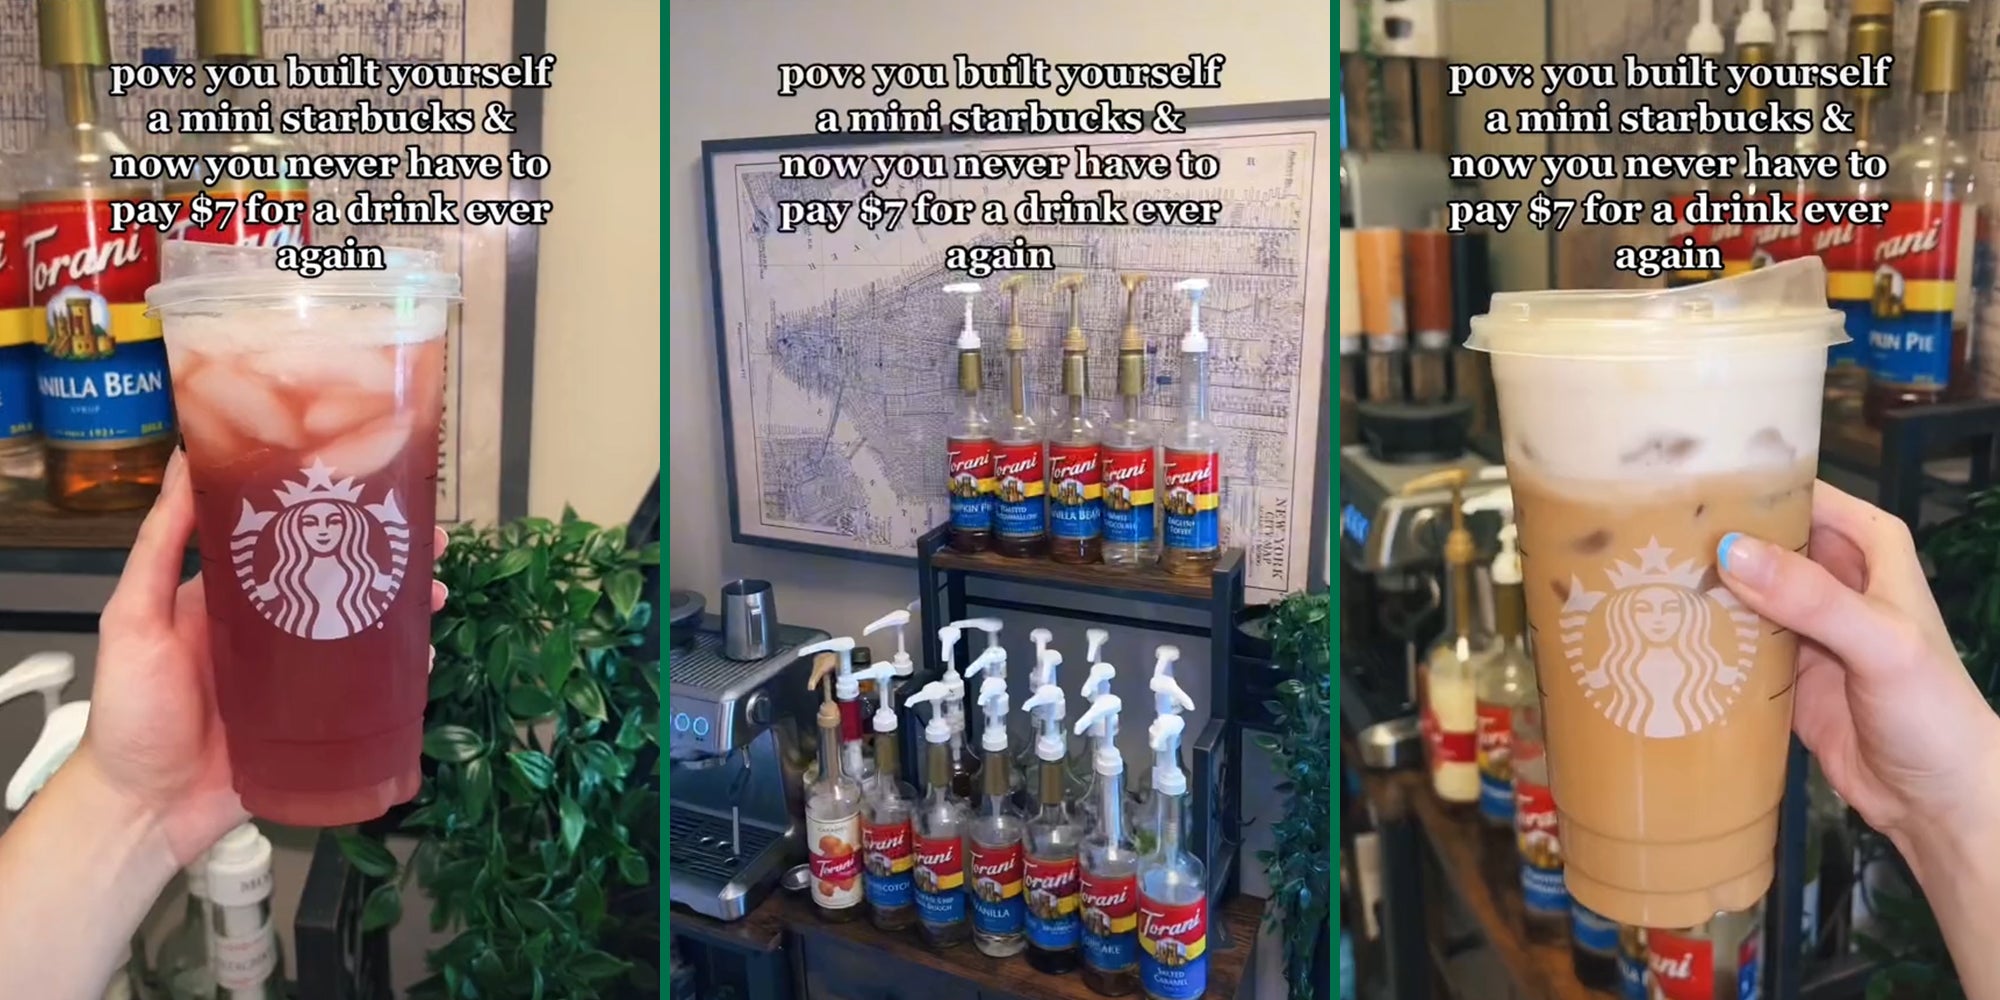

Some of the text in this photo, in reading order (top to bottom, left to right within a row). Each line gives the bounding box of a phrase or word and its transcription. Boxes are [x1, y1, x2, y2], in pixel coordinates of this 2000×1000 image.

[1874, 219, 1942, 261] rani
[24, 226, 141, 306] Torani
[1906, 331, 1934, 353] PIE
[104, 371, 162, 398] BEAN
[947, 450, 991, 474] Torani
[993, 452, 1038, 478] Torani
[1050, 453, 1098, 481] Torani
[1163, 462, 1212, 486] Torani
[1263, 511, 1275, 565] CITY MAP
[1272, 497, 1288, 580] NEW YORK
[817, 854, 855, 878] Torani
[970, 850, 1016, 876] Torani
[1022, 859, 1076, 888] Torani
[1080, 880, 1128, 906] Torani
[1141, 908, 1200, 936] Torani
[1153, 974, 1189, 987] CARAMEL
